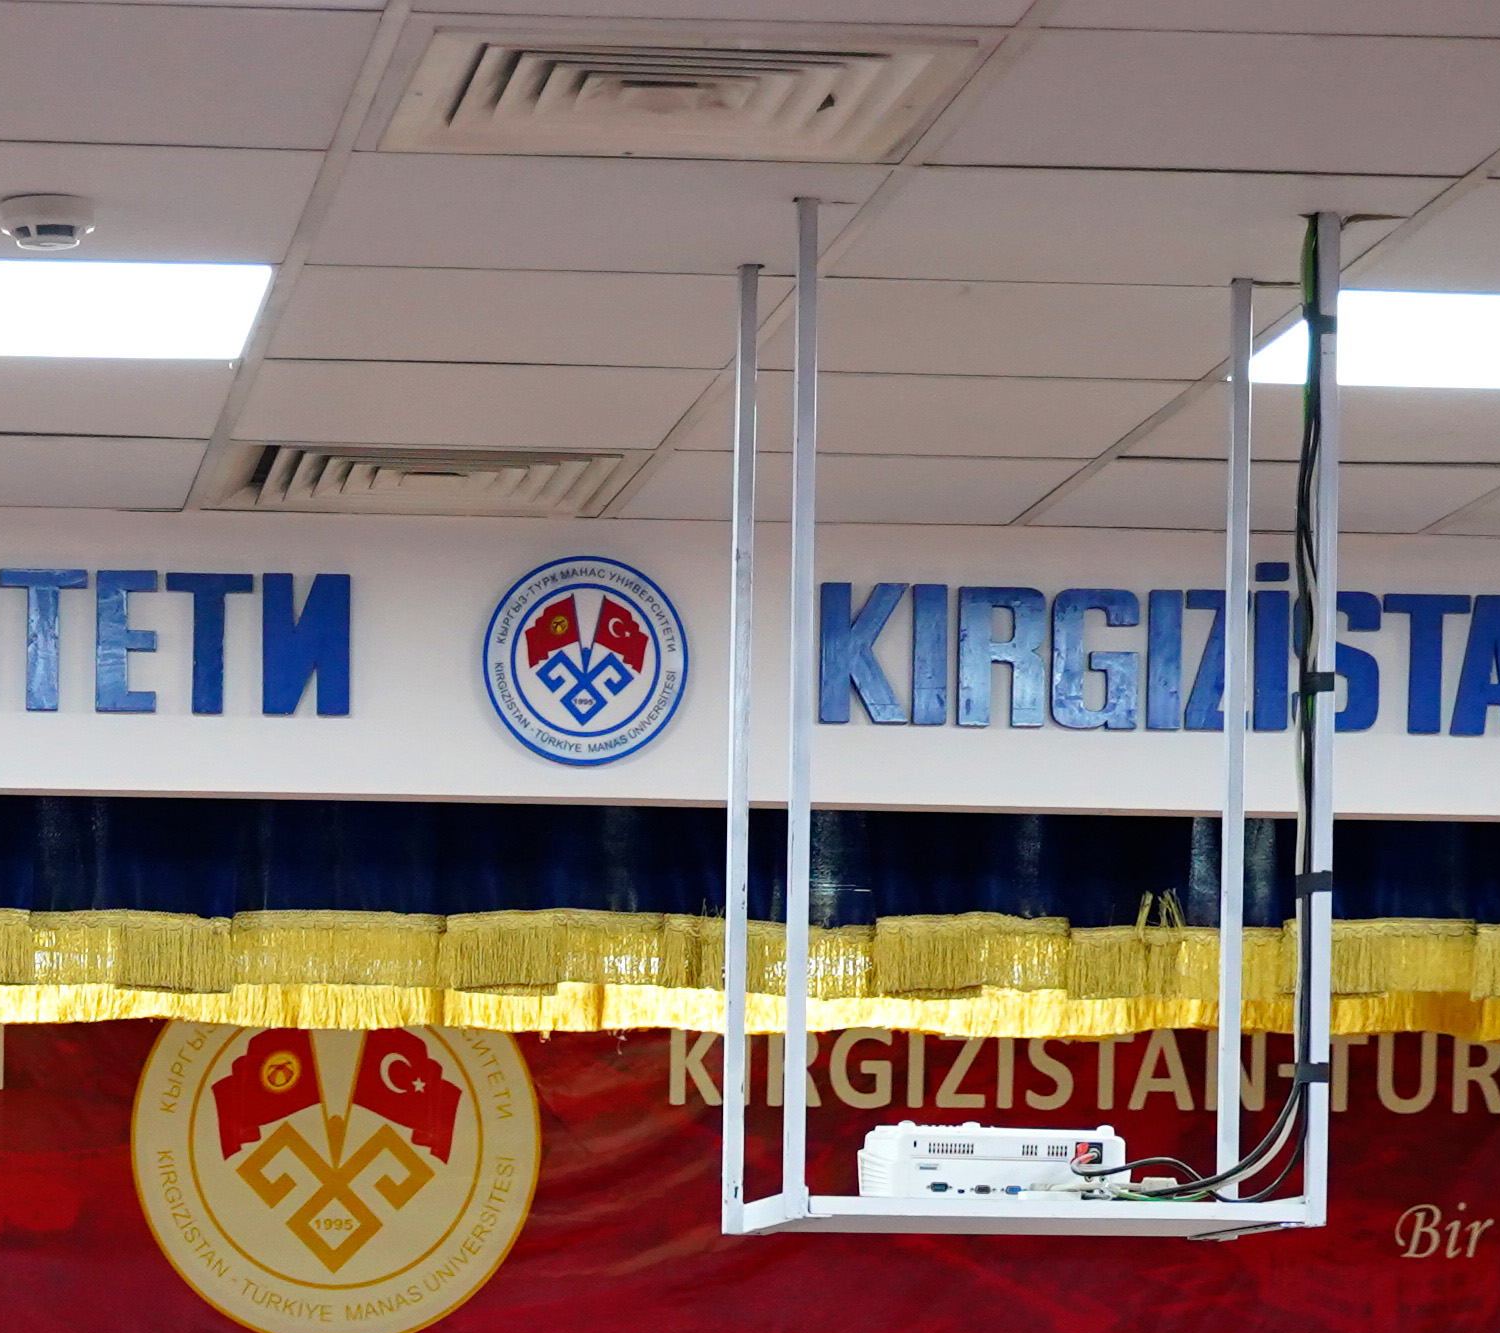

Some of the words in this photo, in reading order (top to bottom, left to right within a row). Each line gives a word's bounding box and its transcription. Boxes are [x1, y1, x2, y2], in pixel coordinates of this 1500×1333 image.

[560, 566, 607, 580] МАНАС
[608, 571, 677, 653] УНИВЕРСИТЕТИ
[588, 734, 629, 753] MANAS
[314, 1218, 354, 1231] 1995
[1395, 1202, 1494, 1258] Bir
[345, 1285, 424, 1321] MANAS
